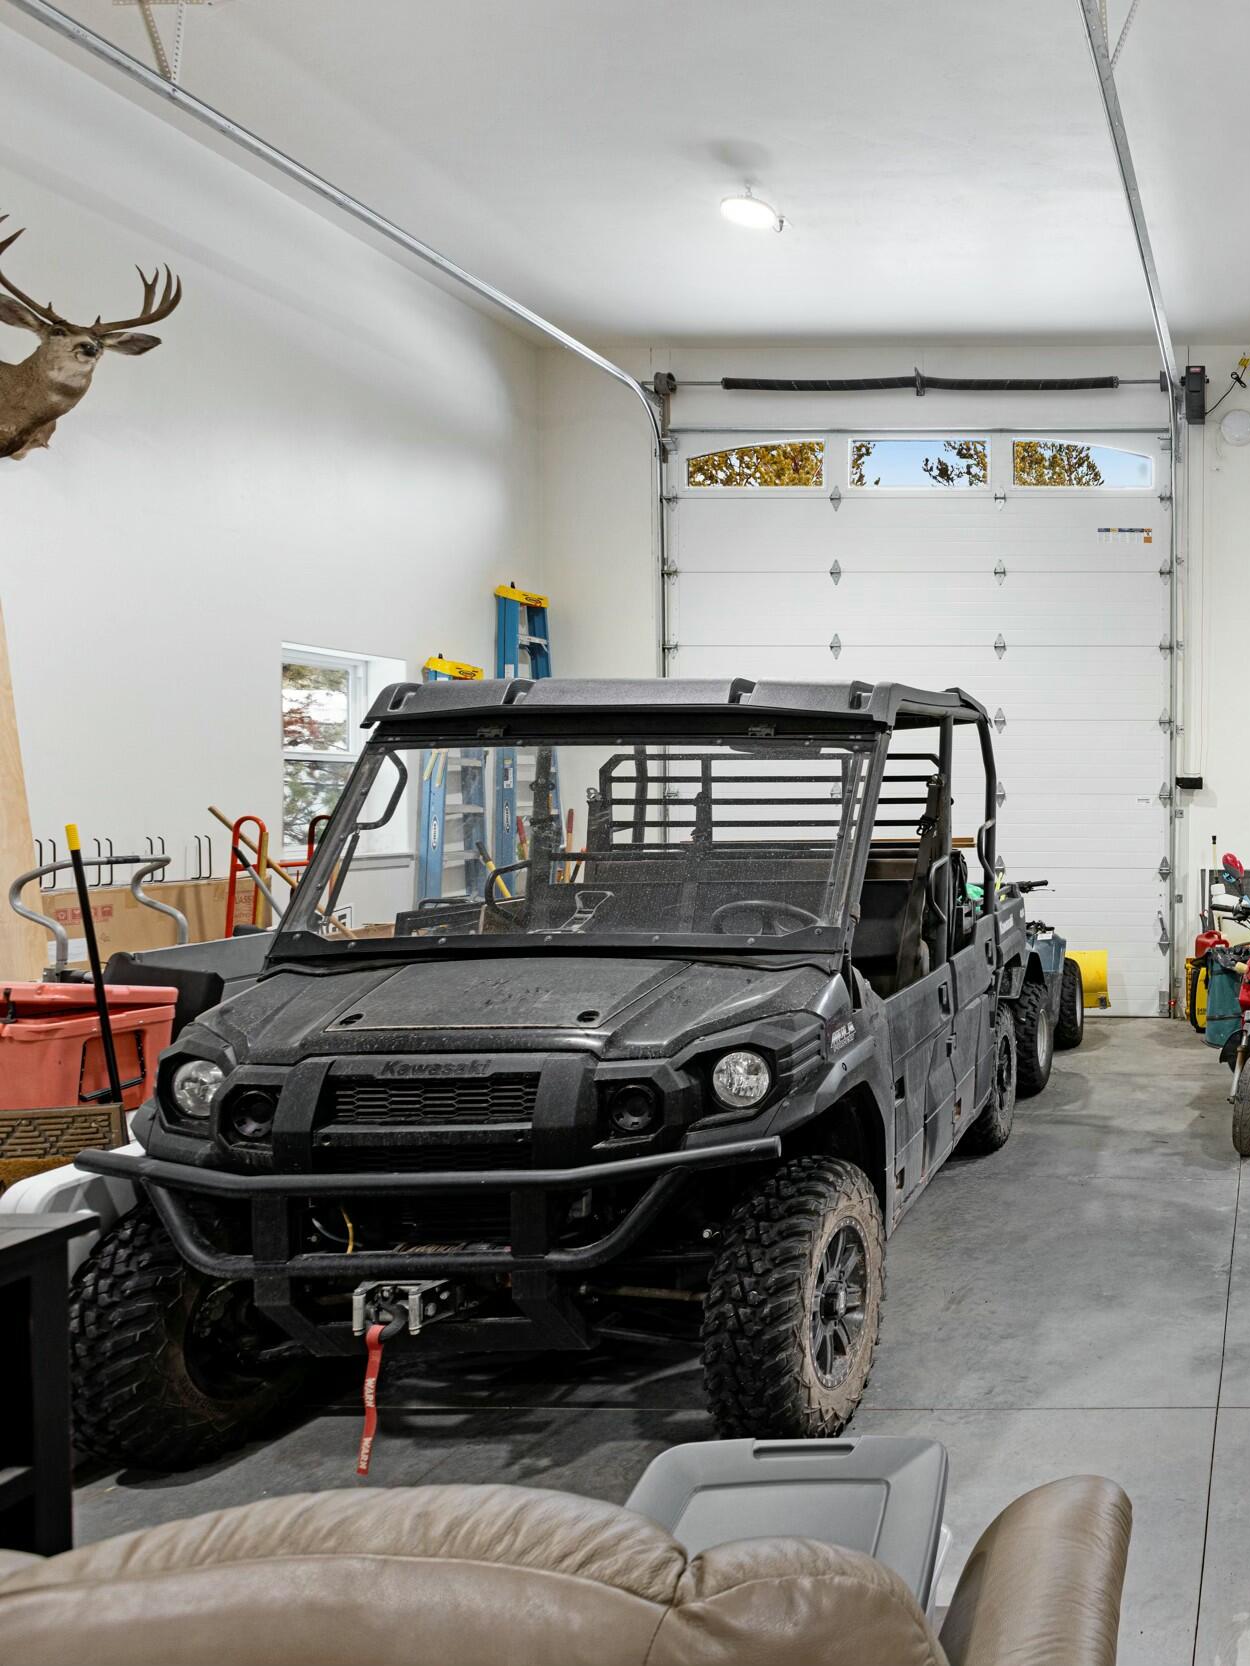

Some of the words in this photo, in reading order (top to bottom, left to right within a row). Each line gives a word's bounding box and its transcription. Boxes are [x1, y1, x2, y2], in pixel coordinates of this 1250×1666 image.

[380, 1059, 493, 1077] Kawasaki
[363, 1377, 377, 1408] WARN
[358, 1437, 373, 1470] WARN
